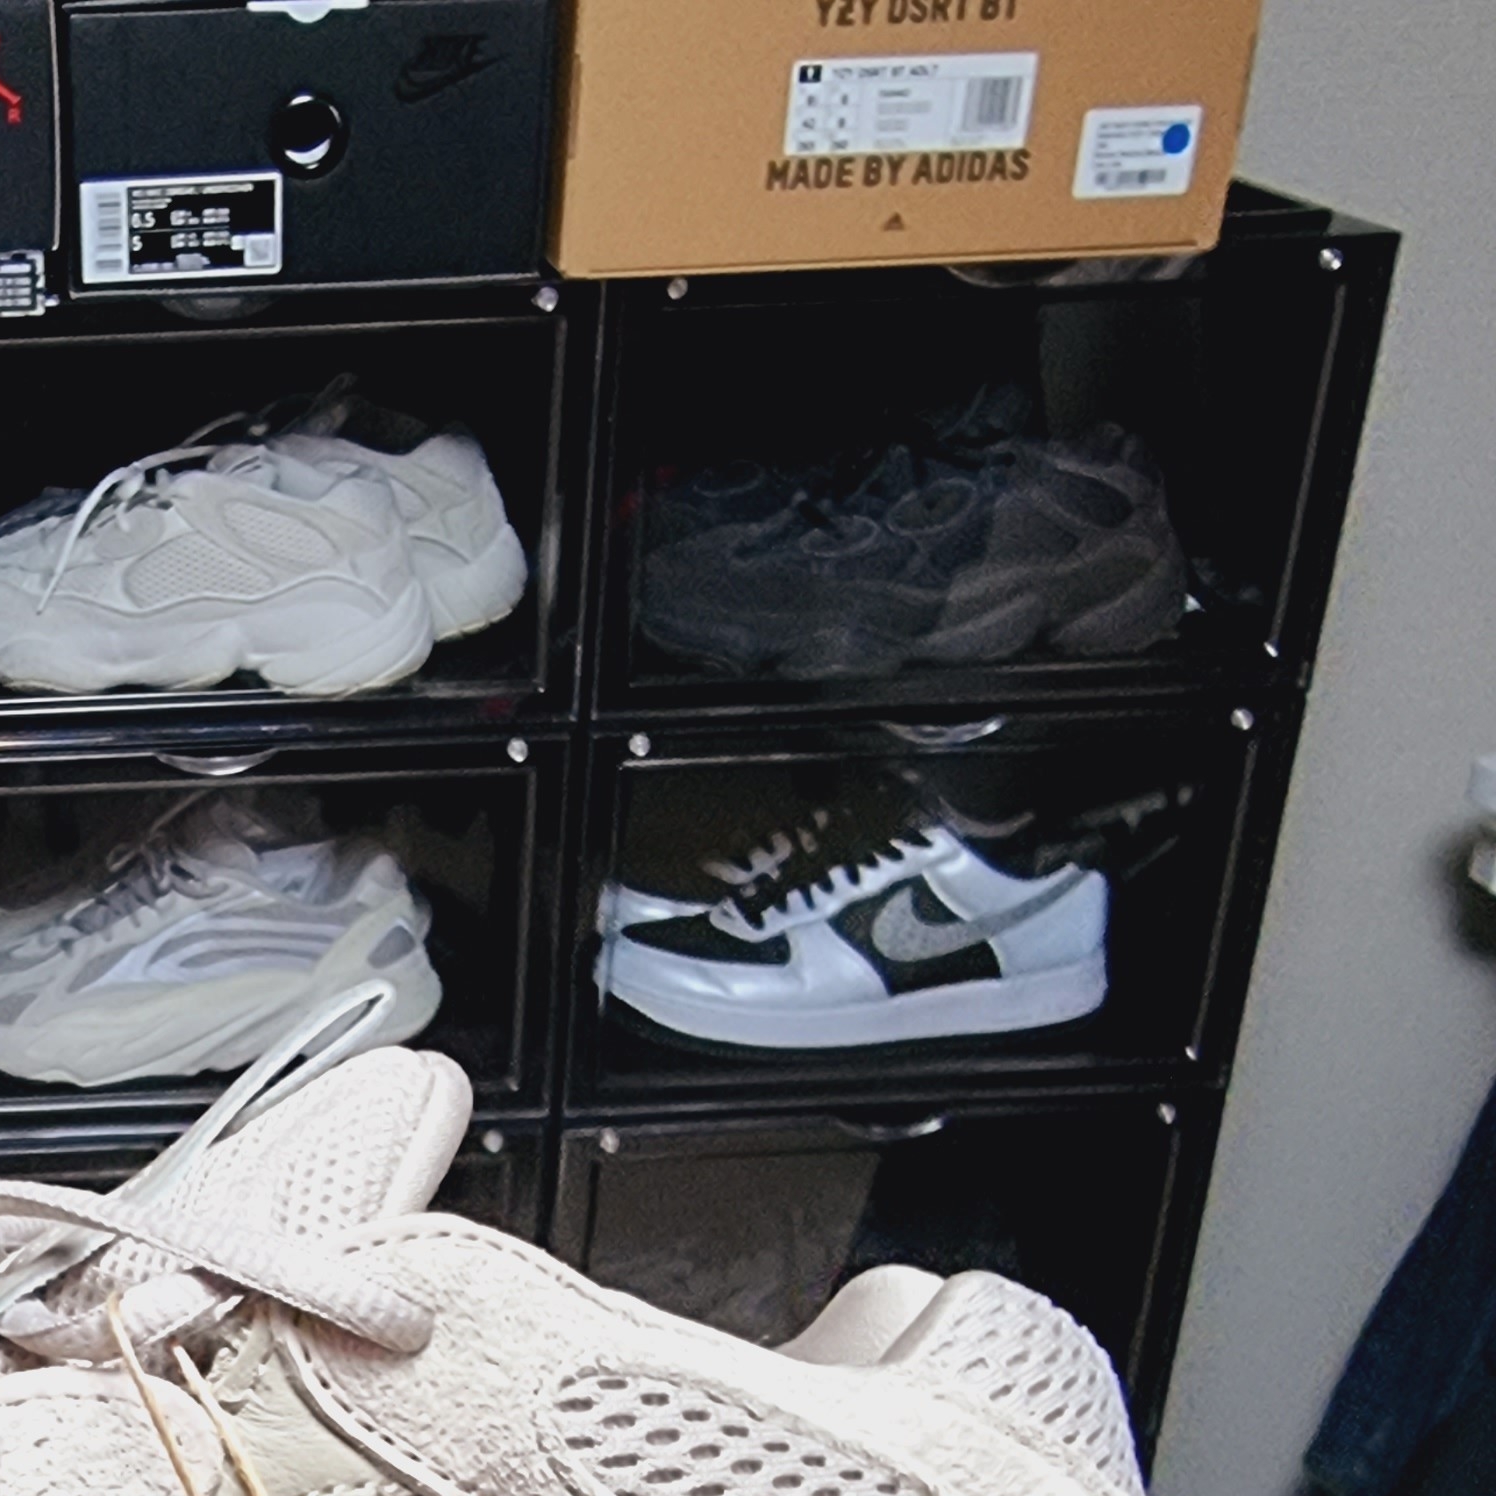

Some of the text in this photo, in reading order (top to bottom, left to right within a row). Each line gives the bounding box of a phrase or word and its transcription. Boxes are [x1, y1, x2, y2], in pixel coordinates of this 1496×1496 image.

[816, 0, 878, 27] YZY
[765, 149, 1031, 191] MADE BY ADIDAS
